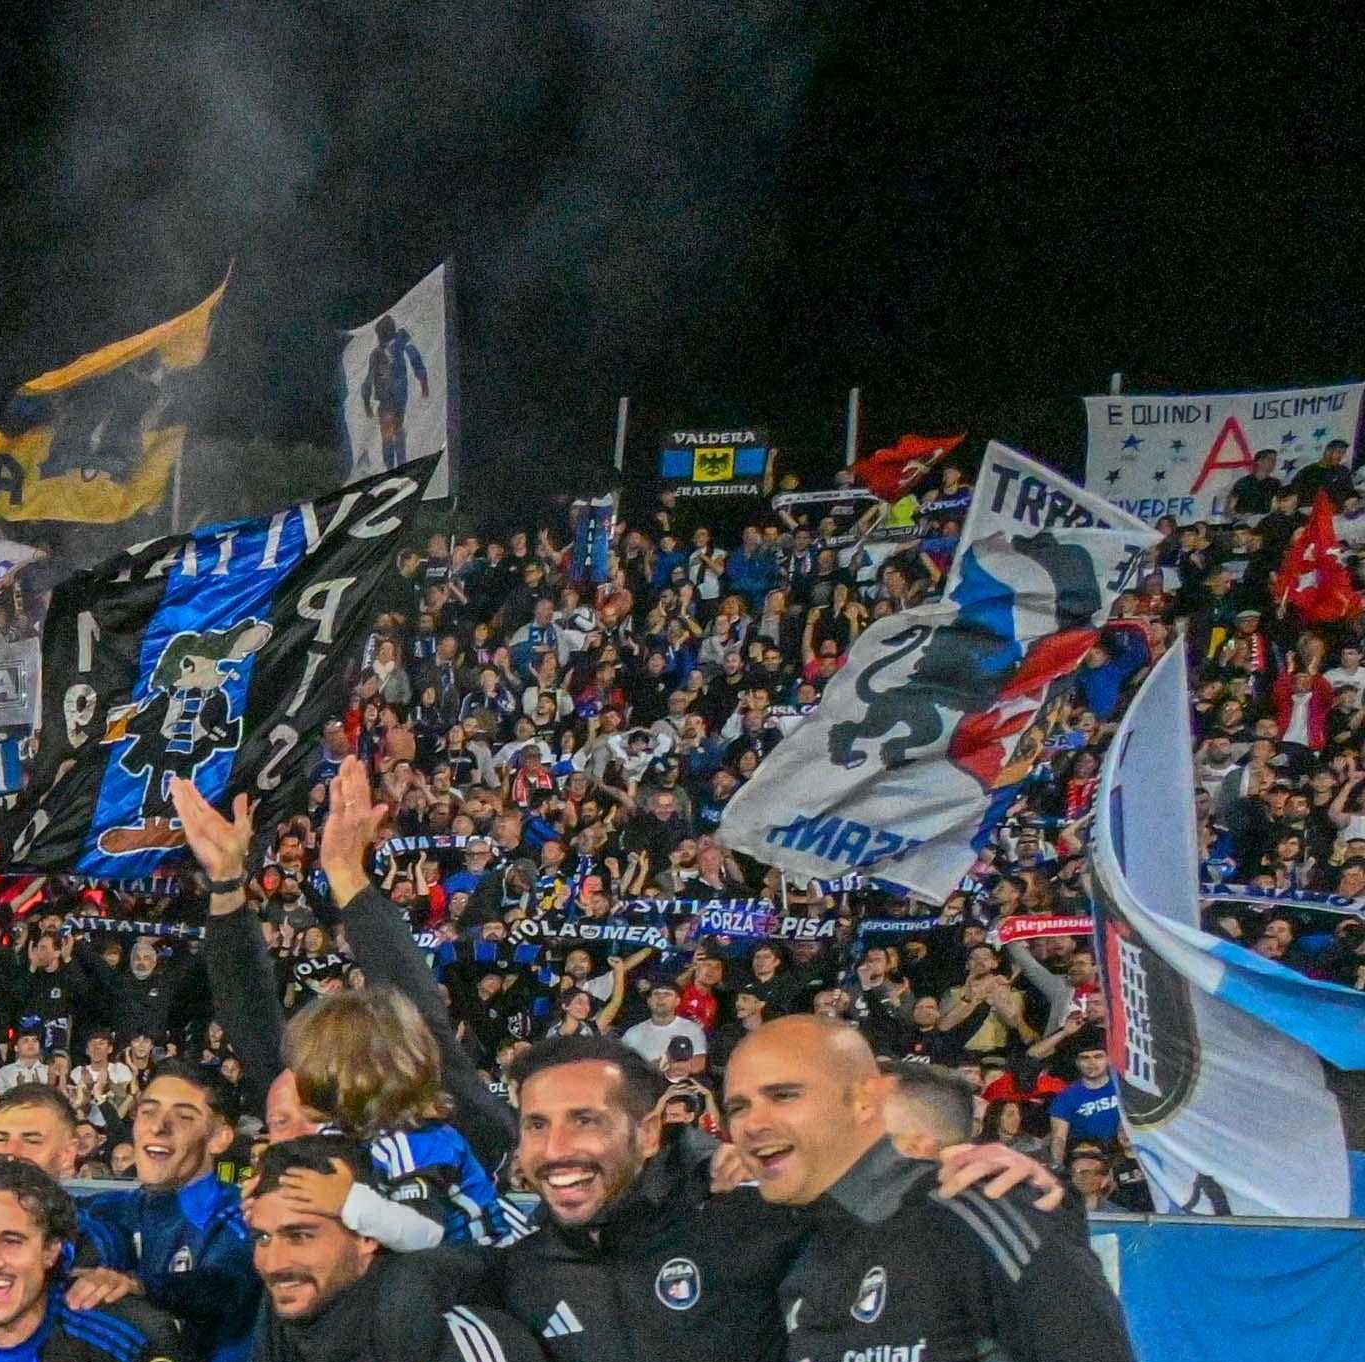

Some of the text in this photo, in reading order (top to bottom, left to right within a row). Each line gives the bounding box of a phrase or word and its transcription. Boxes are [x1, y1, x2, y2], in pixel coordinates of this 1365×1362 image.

[1107, 404, 1124, 425] E
[1131, 404, 1212, 426] QUINDI
[672, 431, 756, 446] VALDERA
[675, 484, 759, 498] ERAZZURRA
[700, 911, 837, 938] FORZA PISA
